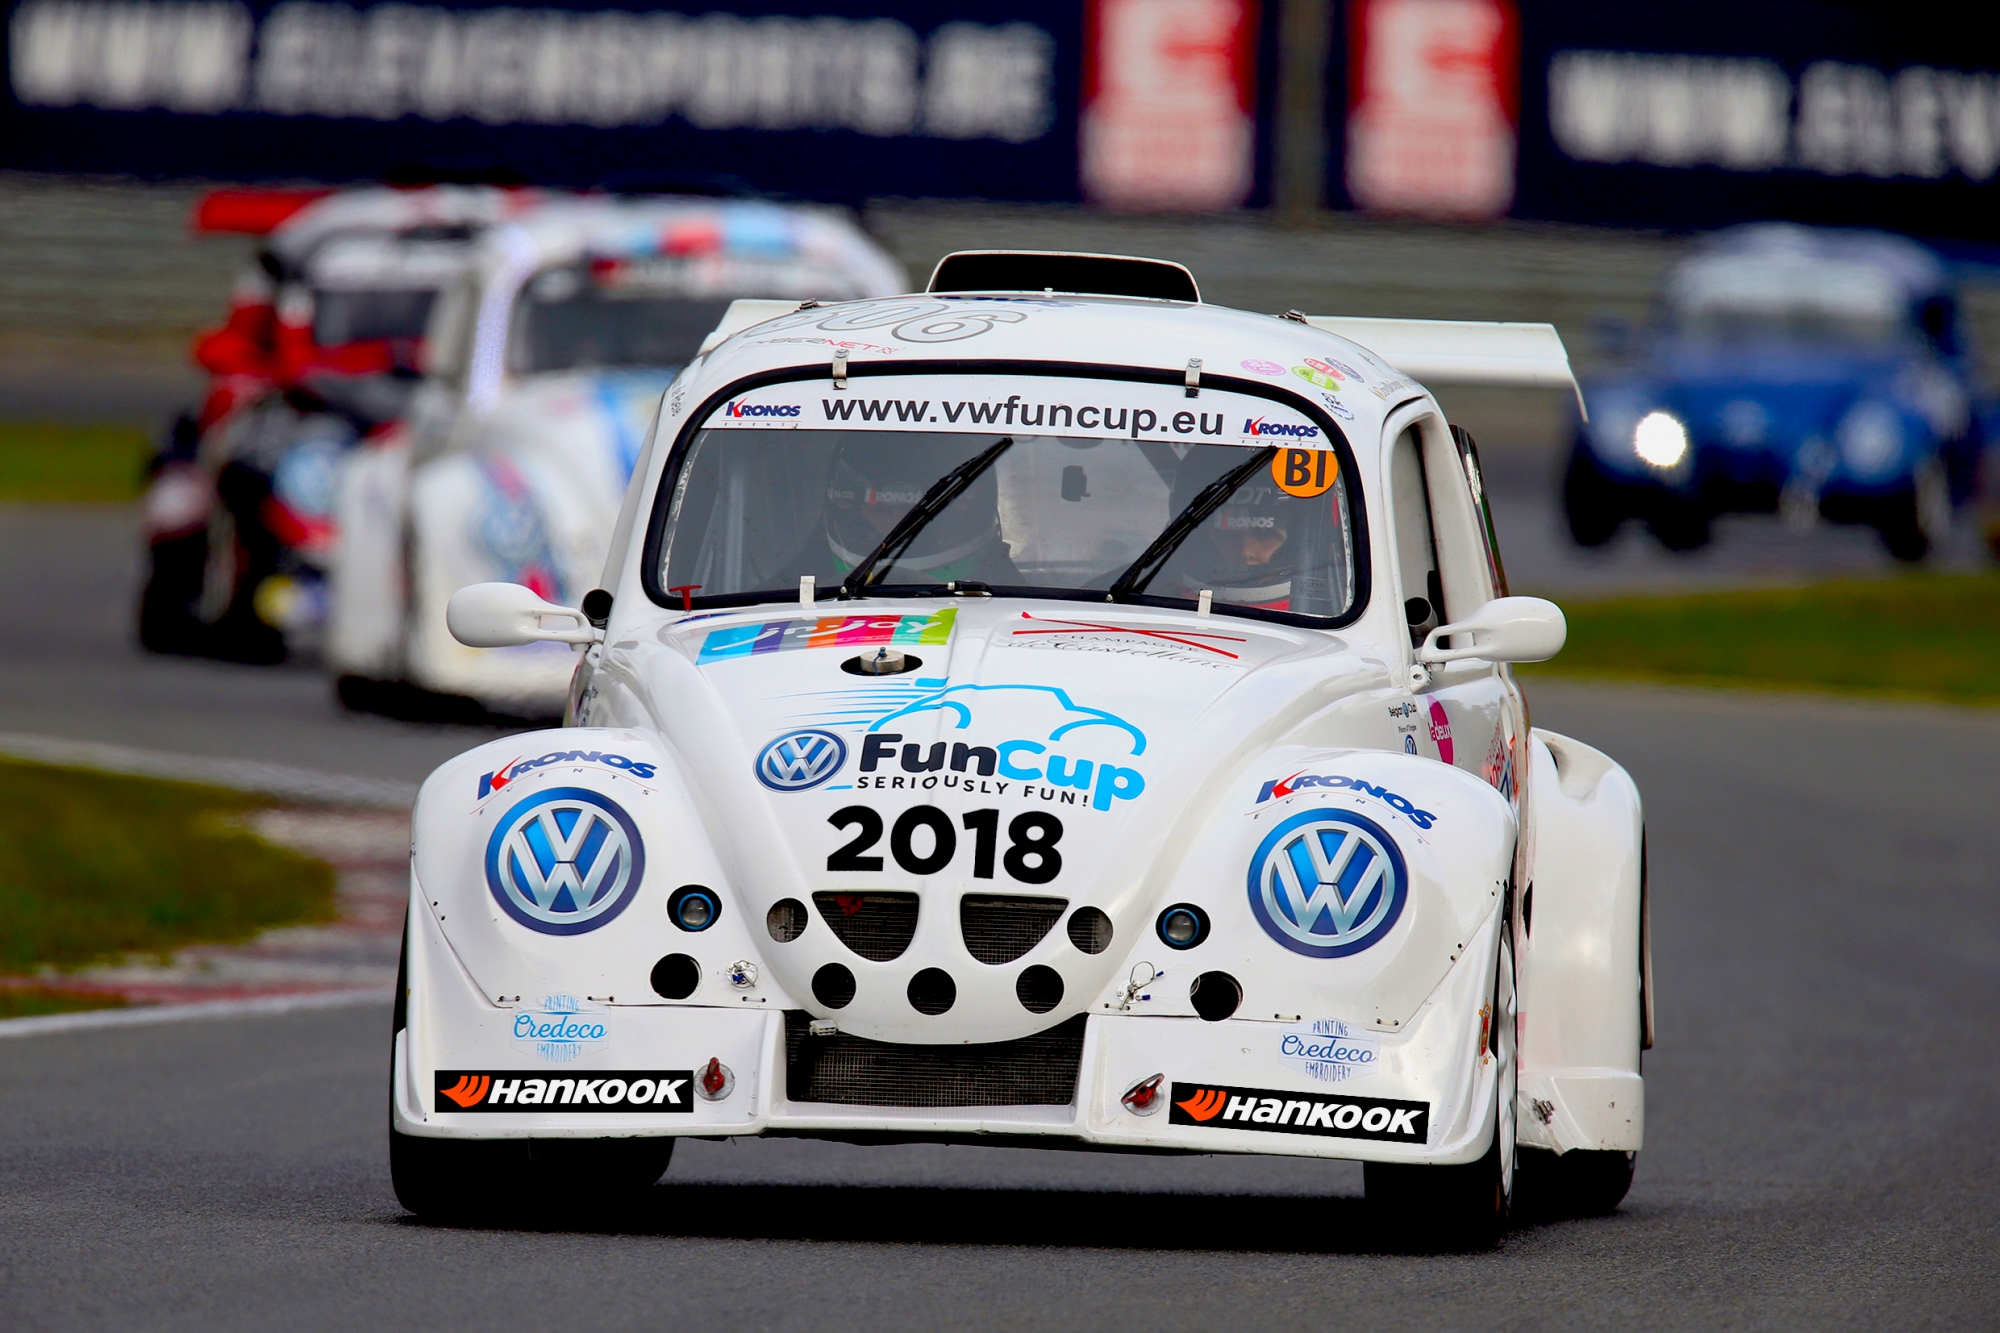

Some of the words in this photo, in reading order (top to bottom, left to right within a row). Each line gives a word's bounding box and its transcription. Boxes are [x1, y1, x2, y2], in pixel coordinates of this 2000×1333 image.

[725, 397, 801, 418] KRONOS
[822, 395, 1224, 438] www.vwfuncup.eu
[1243, 415, 1319, 438] KRONOS
[1054, 634, 1199, 652] CHAMPAGNE
[477, 750, 659, 801] KRONOS
[858, 733, 1146, 812] FunCup
[857, 775, 1009, 795] SERIOUSLY
[1023, 785, 1089, 808] FUN!
[1255, 768, 1438, 831] KRONOS
[826, 804, 1064, 884] 2018
[544, 994, 580, 1012] PRINTING
[513, 1014, 608, 1039] Credeco
[1312, 1020, 1349, 1037] PRINTING
[536, 1043, 582, 1063] EMBROIDERY
[1281, 1034, 1377, 1063] Credeco
[1305, 1062, 1352, 1083] EMBROIDERY
